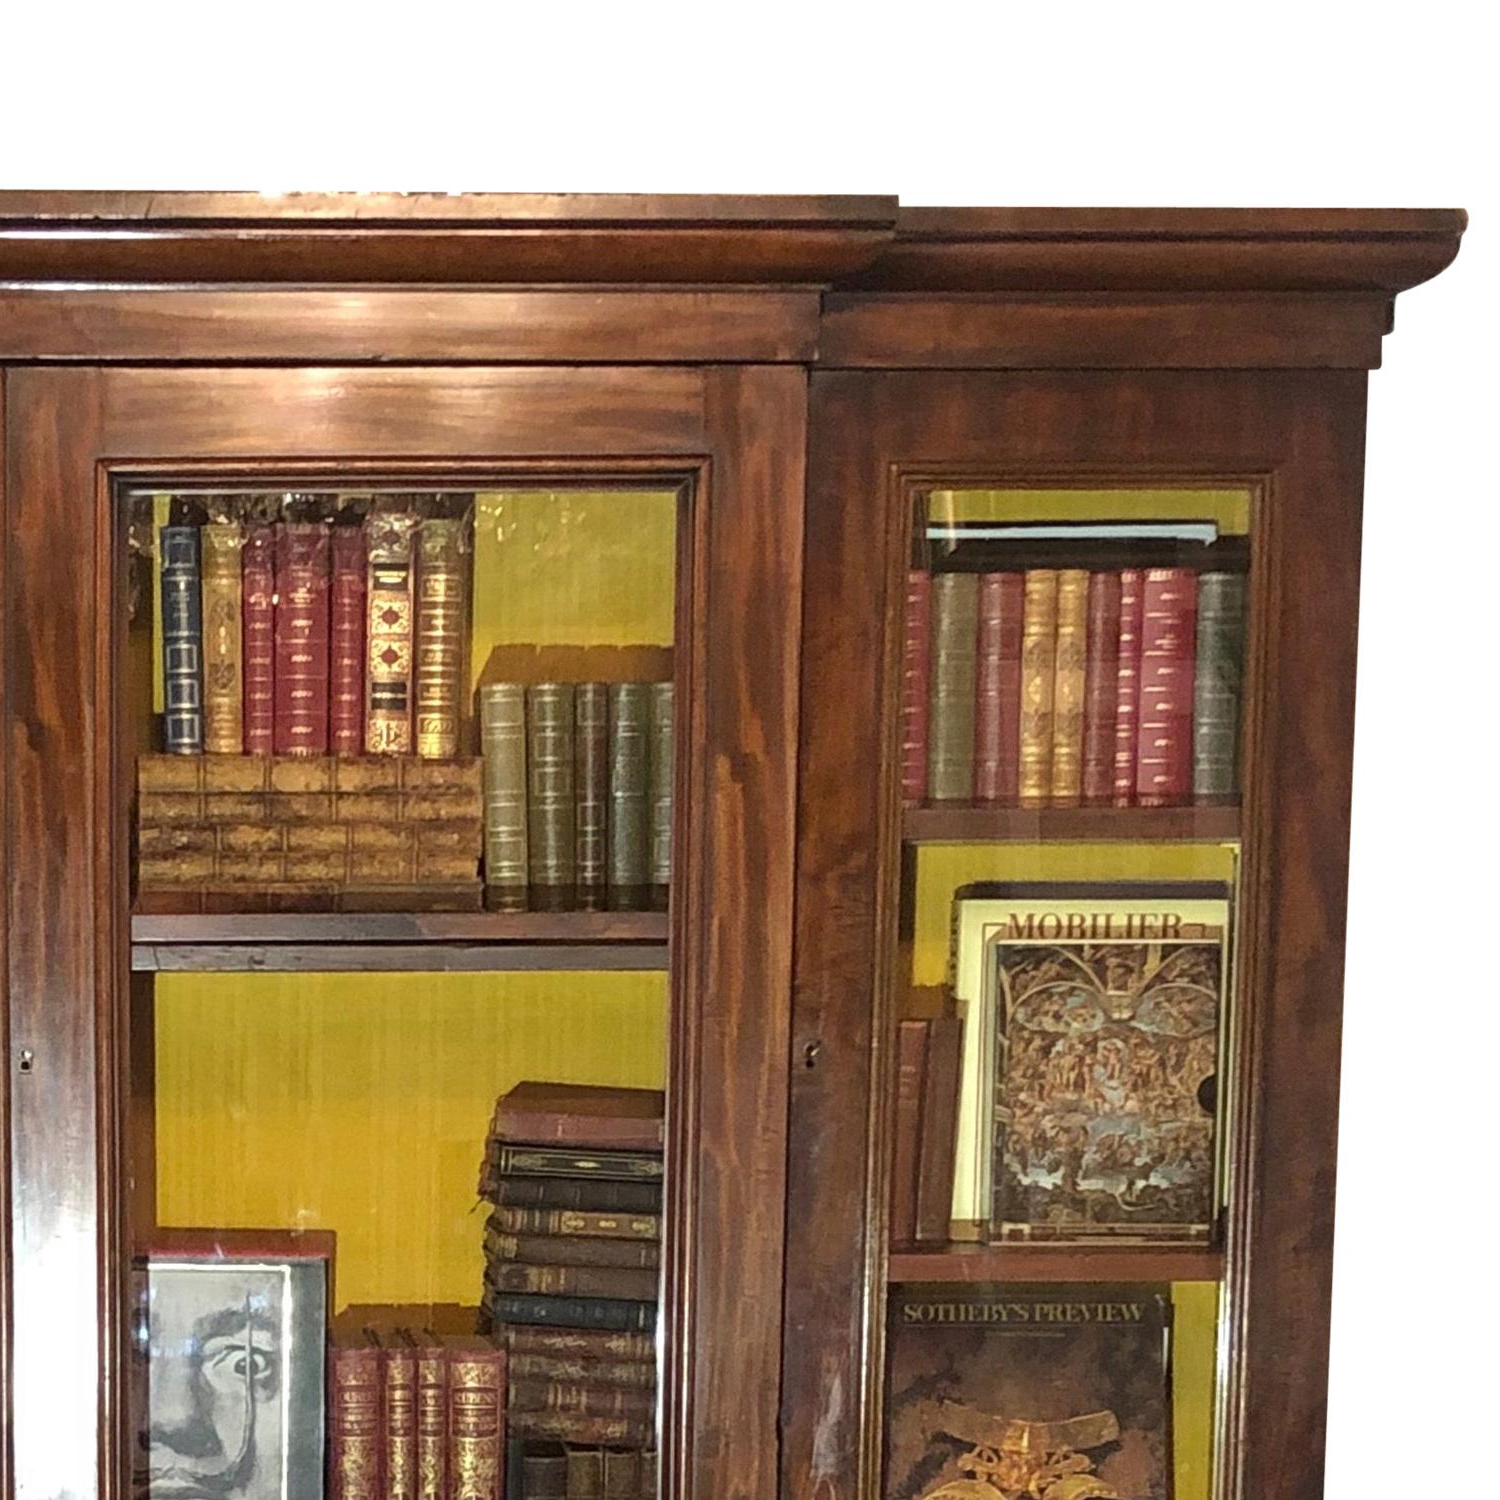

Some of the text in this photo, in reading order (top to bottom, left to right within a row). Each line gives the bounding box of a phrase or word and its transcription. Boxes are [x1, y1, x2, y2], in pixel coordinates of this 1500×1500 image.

[1008, 912, 1182, 939] MOBILIER
[902, 1302, 1145, 1322] SOTHEBY'S PREVIEW
